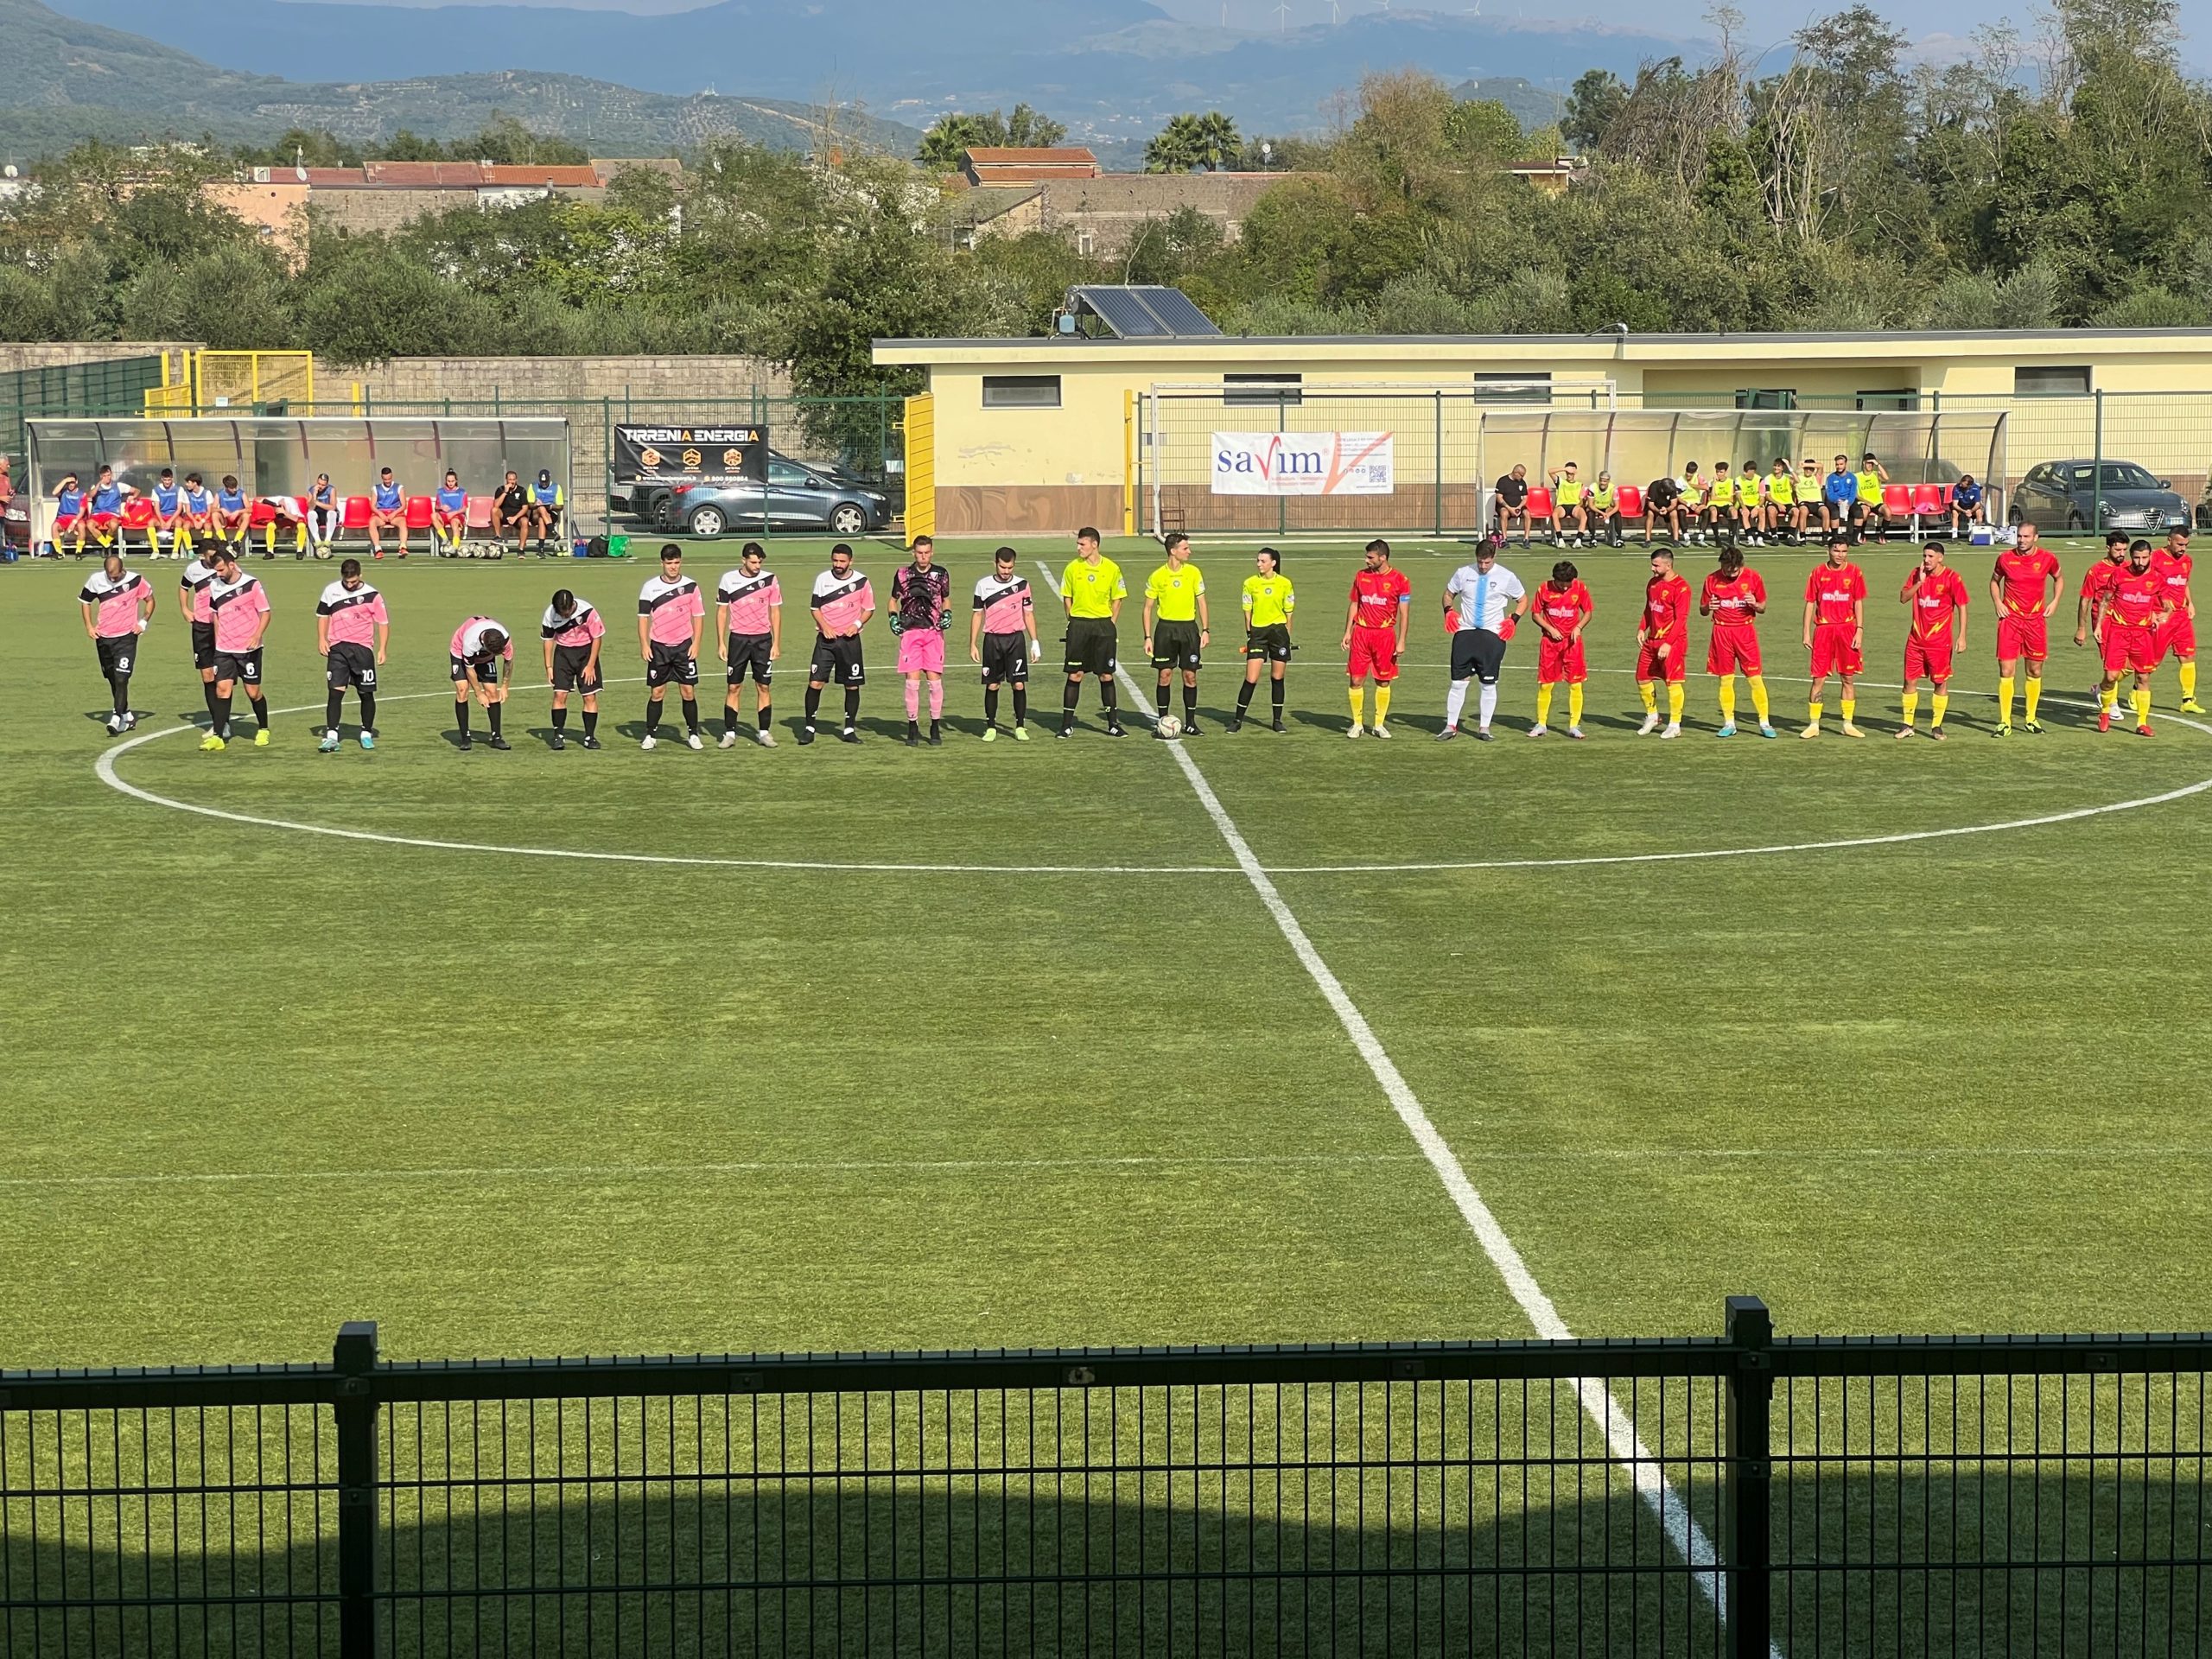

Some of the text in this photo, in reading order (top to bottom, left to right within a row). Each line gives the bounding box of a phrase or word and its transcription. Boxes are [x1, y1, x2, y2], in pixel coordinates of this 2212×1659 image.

[624, 429, 760, 442] TIRRENIA ENERGIA
[1217, 435, 1323, 480] savim
[118, 657, 129, 668] 8
[245, 662, 255, 675] 6
[486, 662, 496, 673] 11
[688, 662, 695, 675] 5
[766, 661, 772, 674] 2
[1015, 658, 1023, 672] 7
[362, 669, 374, 682] 10
[851, 663, 860, 676] 9
